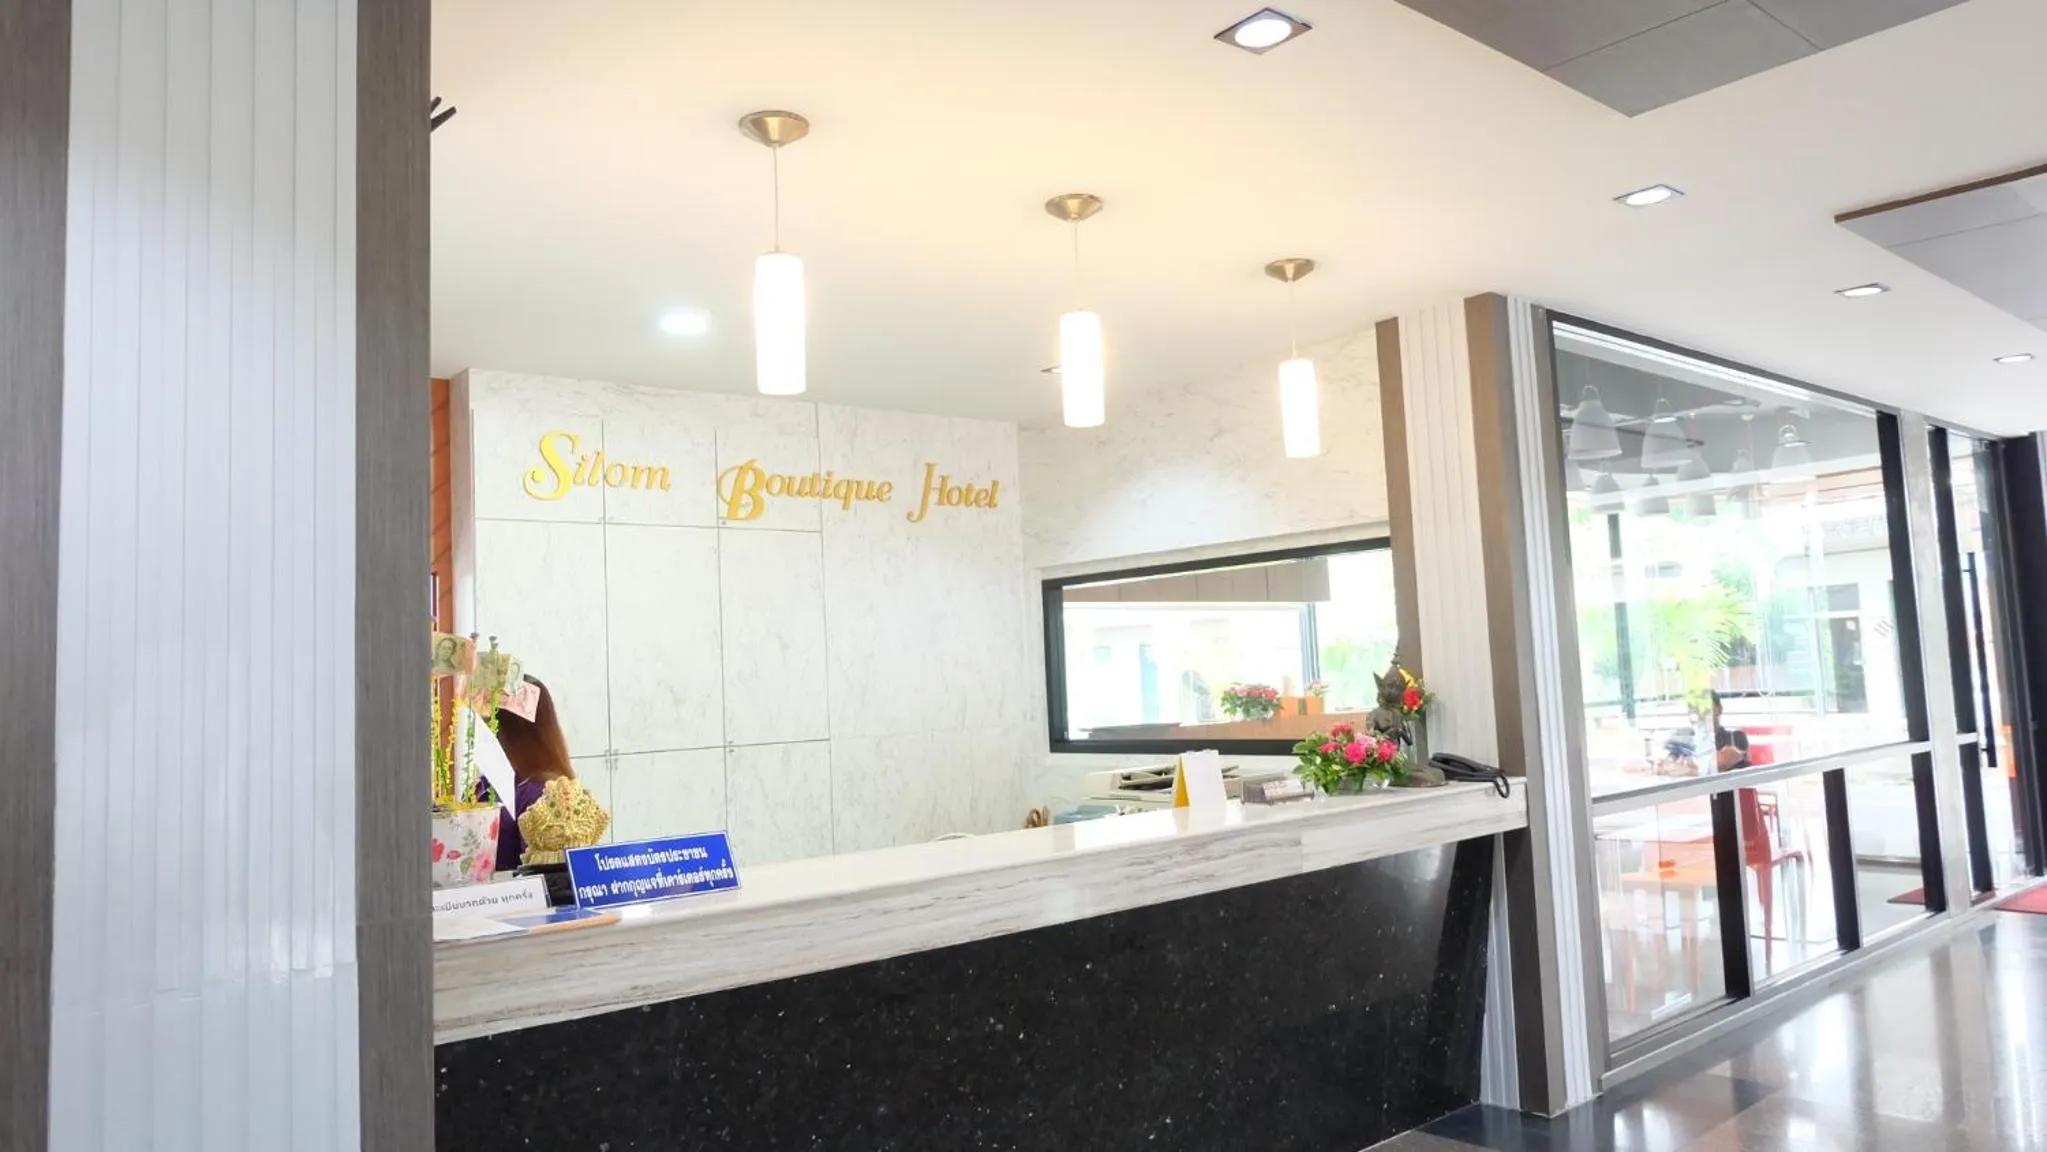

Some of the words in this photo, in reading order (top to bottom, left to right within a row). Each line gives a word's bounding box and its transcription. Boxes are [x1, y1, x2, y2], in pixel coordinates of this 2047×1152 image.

[523, 430, 671, 500] Silom
[718, 458, 893, 520] Boutique
[906, 462, 999, 522] Hotel
[594, 847, 708, 871] โปรดแสดงบัตรประชาชน
[578, 885, 608, 904] กรุณา
